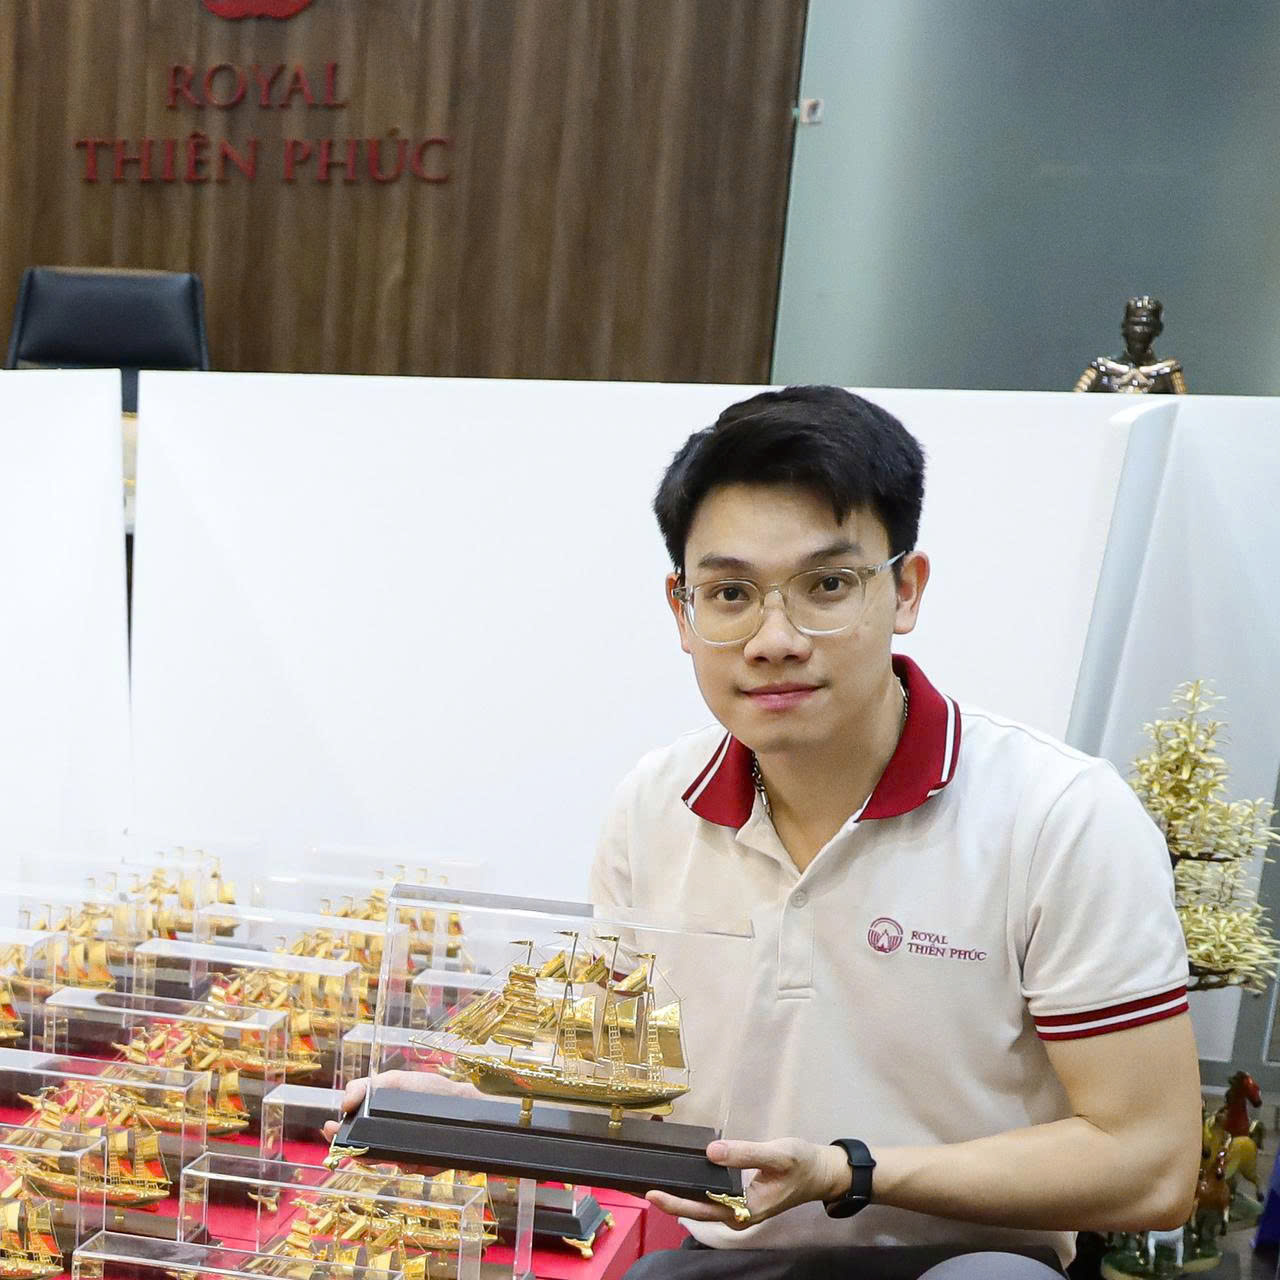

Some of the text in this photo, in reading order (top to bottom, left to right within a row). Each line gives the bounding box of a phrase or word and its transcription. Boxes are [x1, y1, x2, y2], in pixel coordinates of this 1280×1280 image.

[166, 62, 349, 110] ROYAL
[74, 126, 455, 184] THIÊN PHÚC
[907, 942, 987, 961] THIÊN PHÚC
[911, 930, 948, 945] ROYAL
